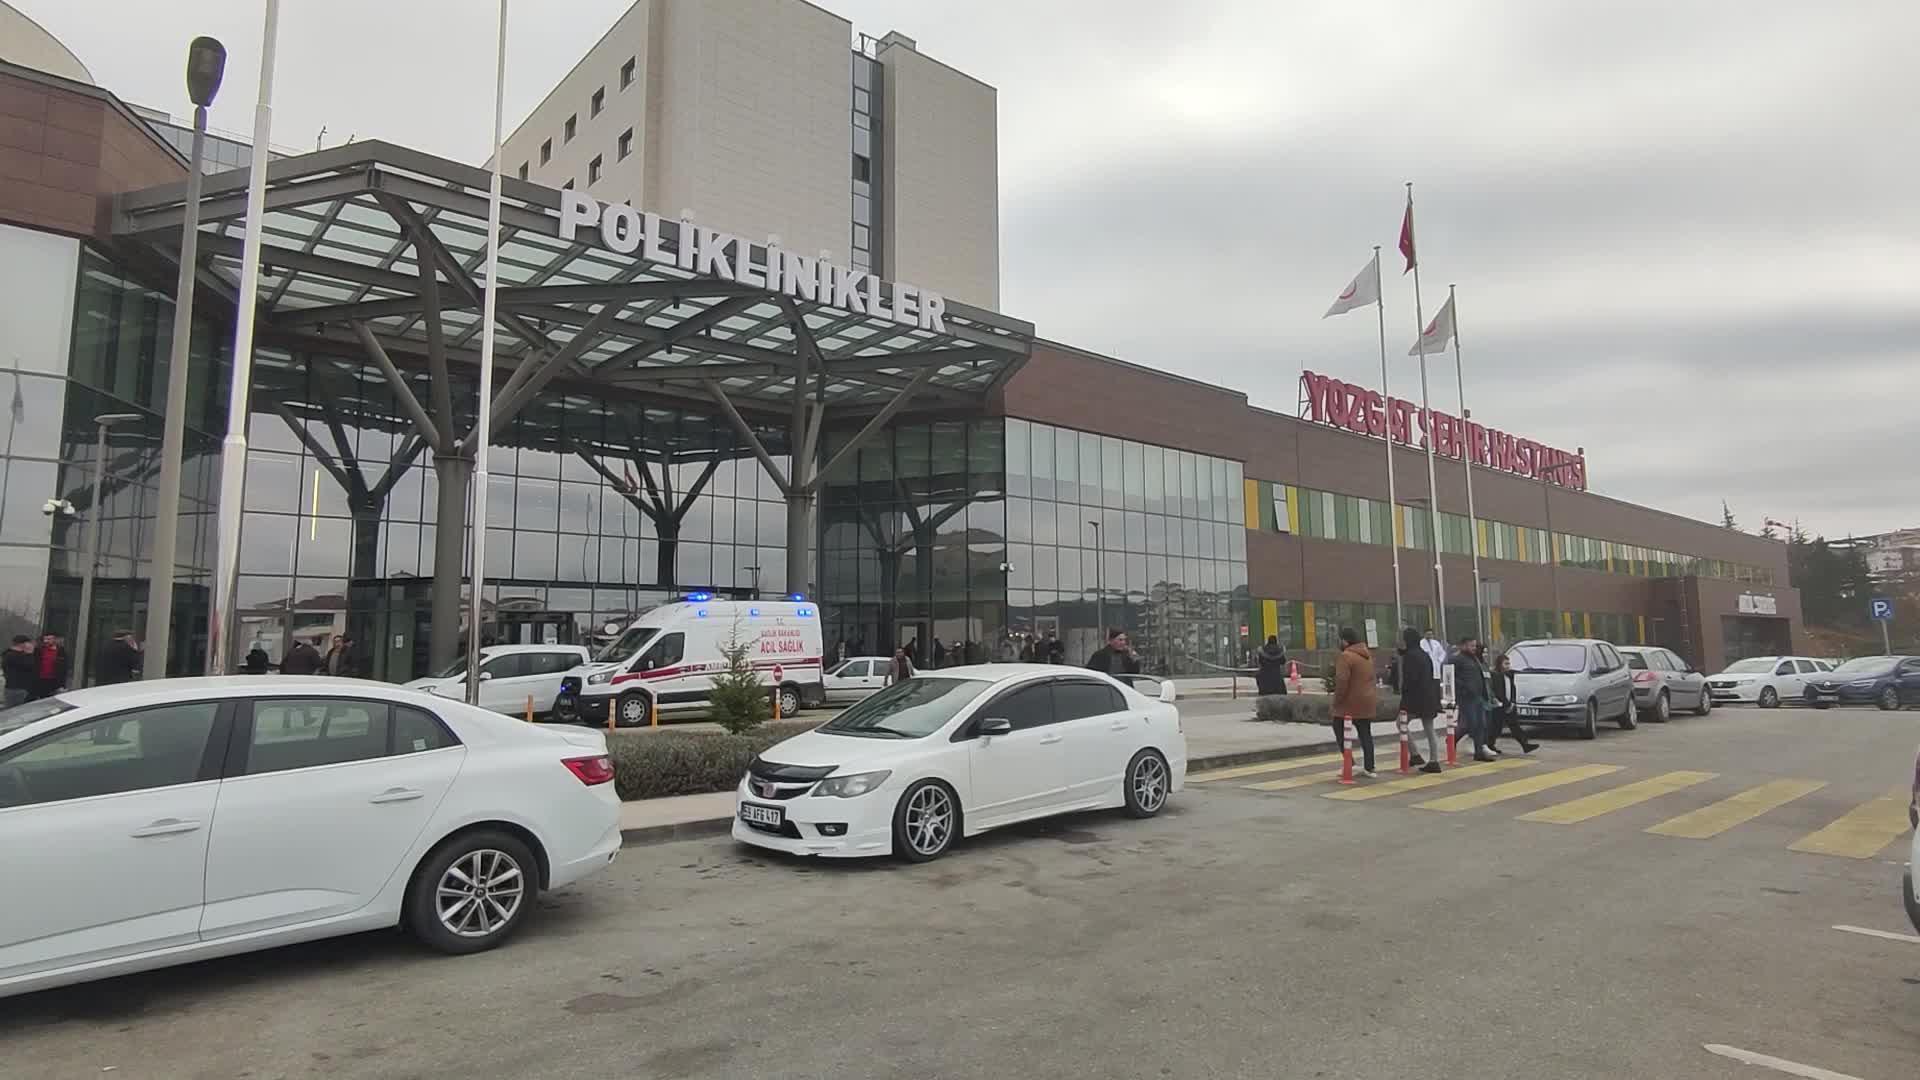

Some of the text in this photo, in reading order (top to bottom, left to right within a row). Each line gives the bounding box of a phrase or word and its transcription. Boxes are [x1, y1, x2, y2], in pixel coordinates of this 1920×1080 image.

[559, 189, 946, 333] POLİKLİNİKLER
[1303, 370, 1415, 444] YOZGAT
[1488, 429, 1586, 491] HASTANESİ
[1874, 601, 1887, 616] P
[766, 809, 779, 823] 417
